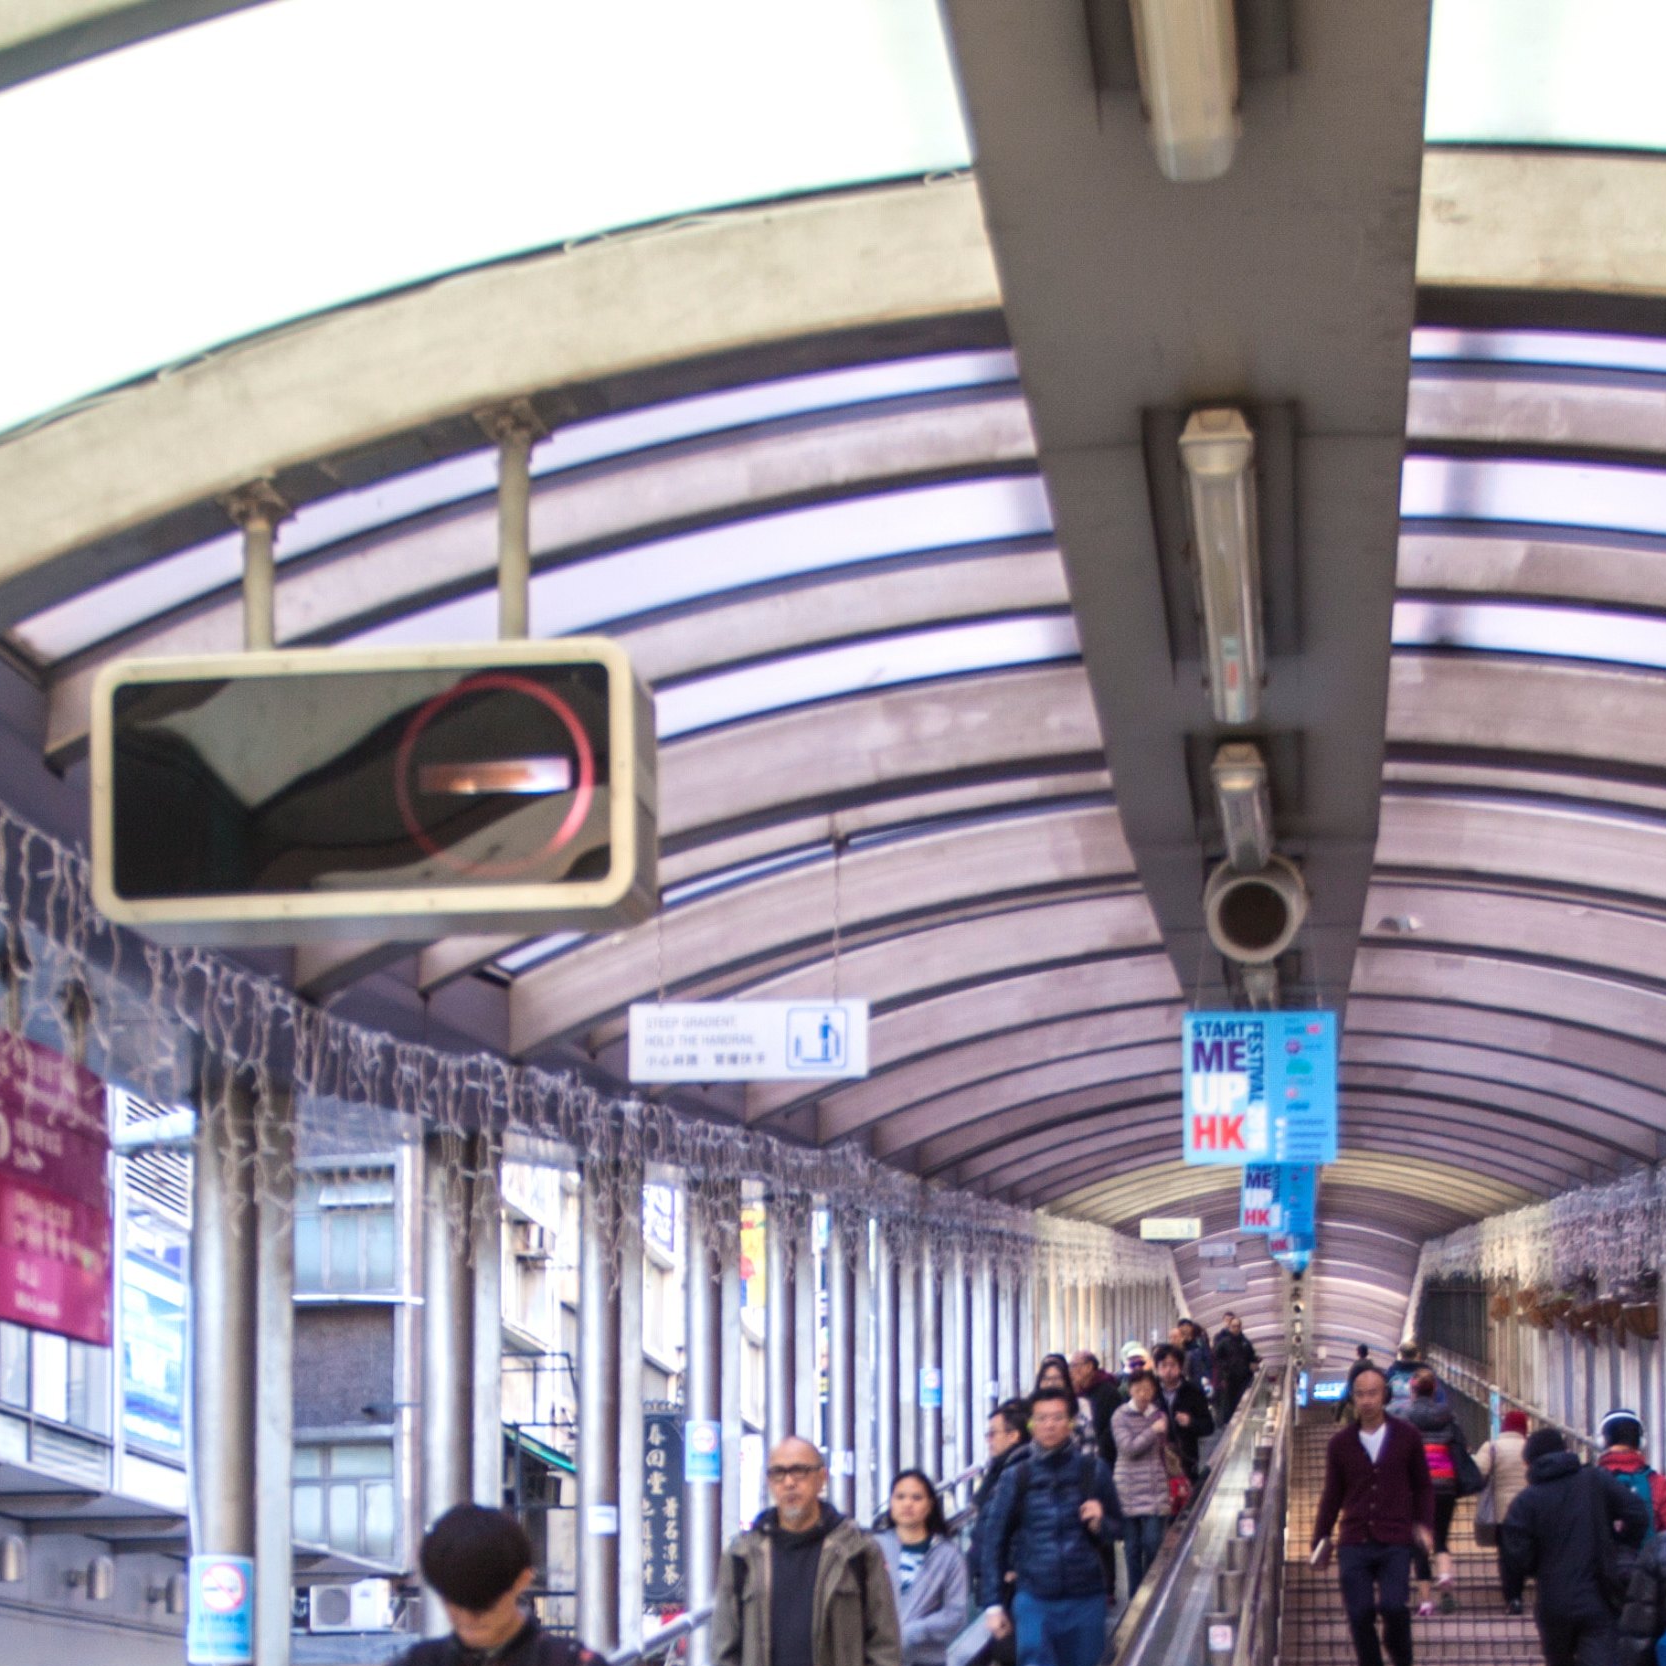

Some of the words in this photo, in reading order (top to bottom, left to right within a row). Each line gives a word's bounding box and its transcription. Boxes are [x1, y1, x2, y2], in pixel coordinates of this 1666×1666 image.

[645, 1016, 679, 1029] STEEP
[682, 1015, 736, 1028] GRADIENT
[1192, 1020, 1245, 1037] START
[645, 1035, 674, 1047] HOLD
[679, 1034, 699, 1046] THE
[702, 1033, 754, 1046] HANDRAIL
[1193, 1039, 1247, 1073] ME
[1247, 1020, 1264, 1105] FESTIVAL
[1192, 1073, 1249, 1113] UP
[1192, 1114, 1246, 1149] HK
[1245, 1171, 1272, 1189] ME
[1244, 1208, 1271, 1226] HK
[646, 1422, 668, 1496] 春回堂
